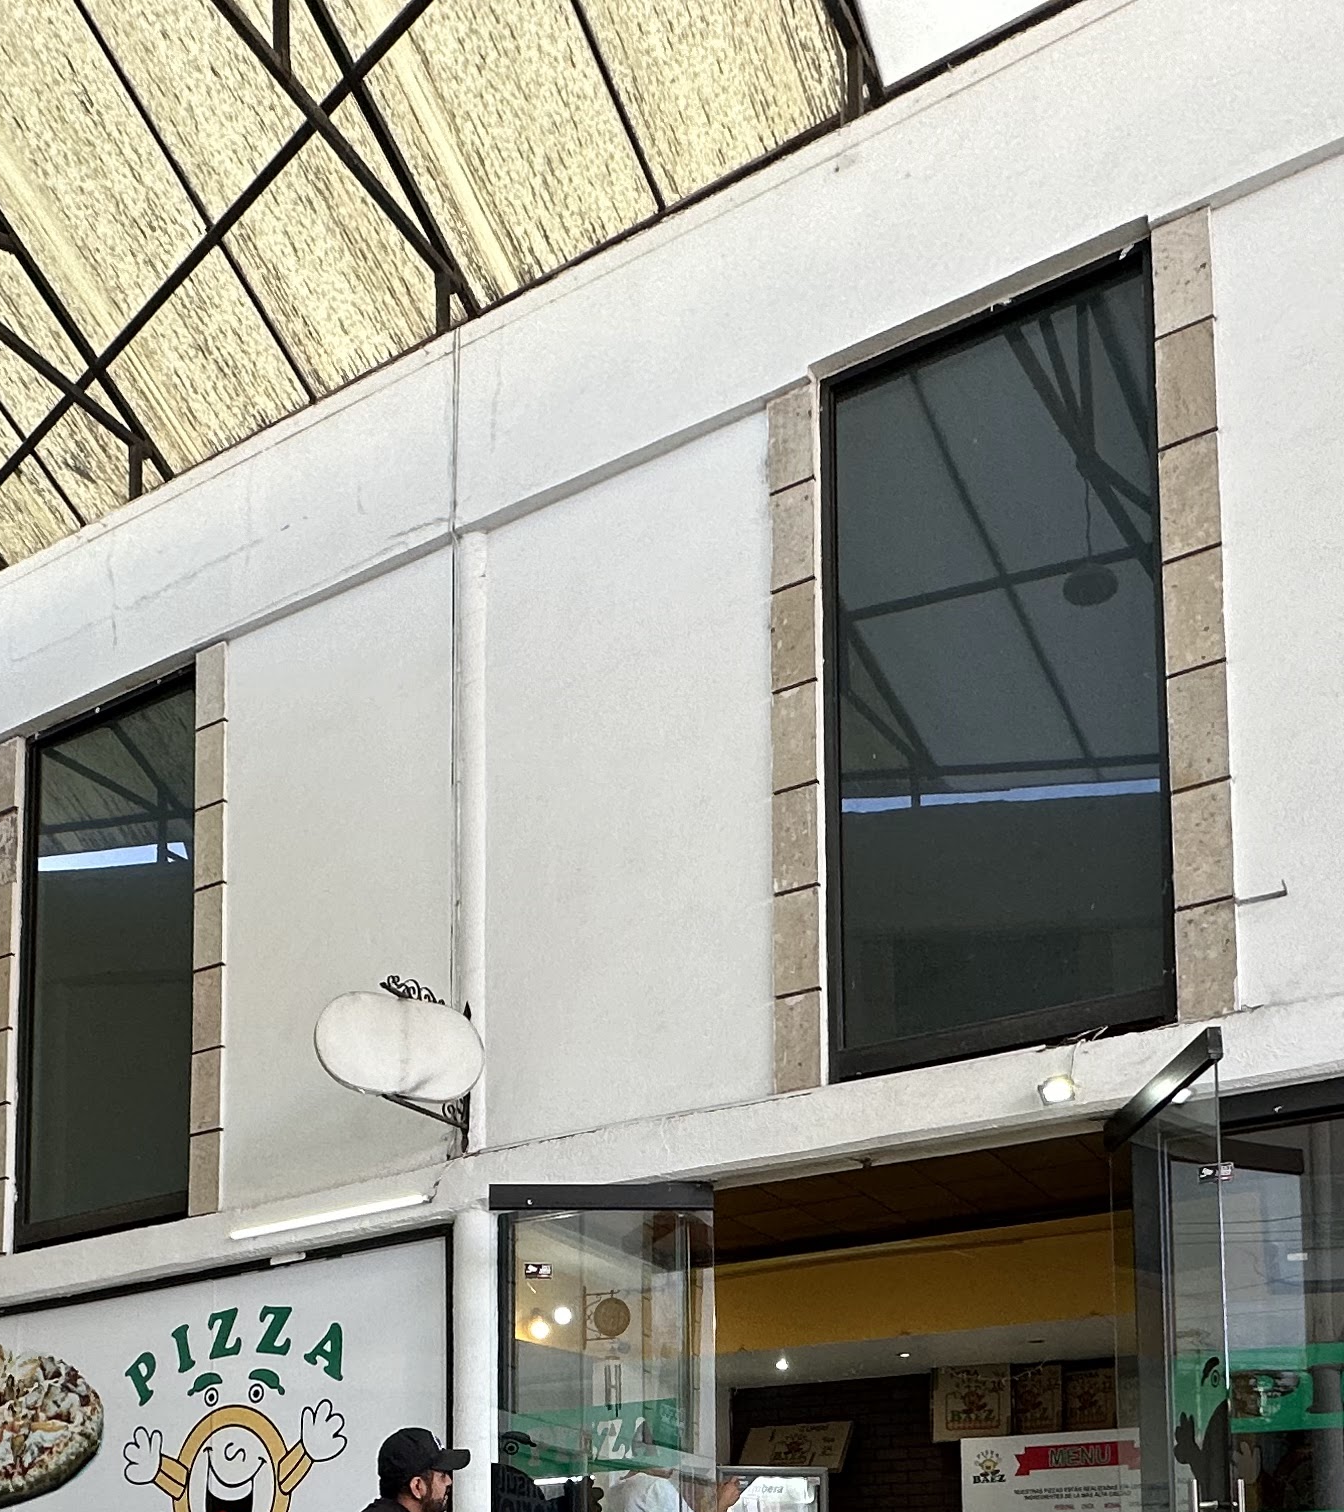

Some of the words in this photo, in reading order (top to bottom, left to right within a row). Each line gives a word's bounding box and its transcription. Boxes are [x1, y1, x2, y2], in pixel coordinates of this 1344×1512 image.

[124, 1305, 343, 1406] PIZZA
[1048, 1444, 1112, 1468] MENU
[972, 1473, 1007, 1485] BAEZ
